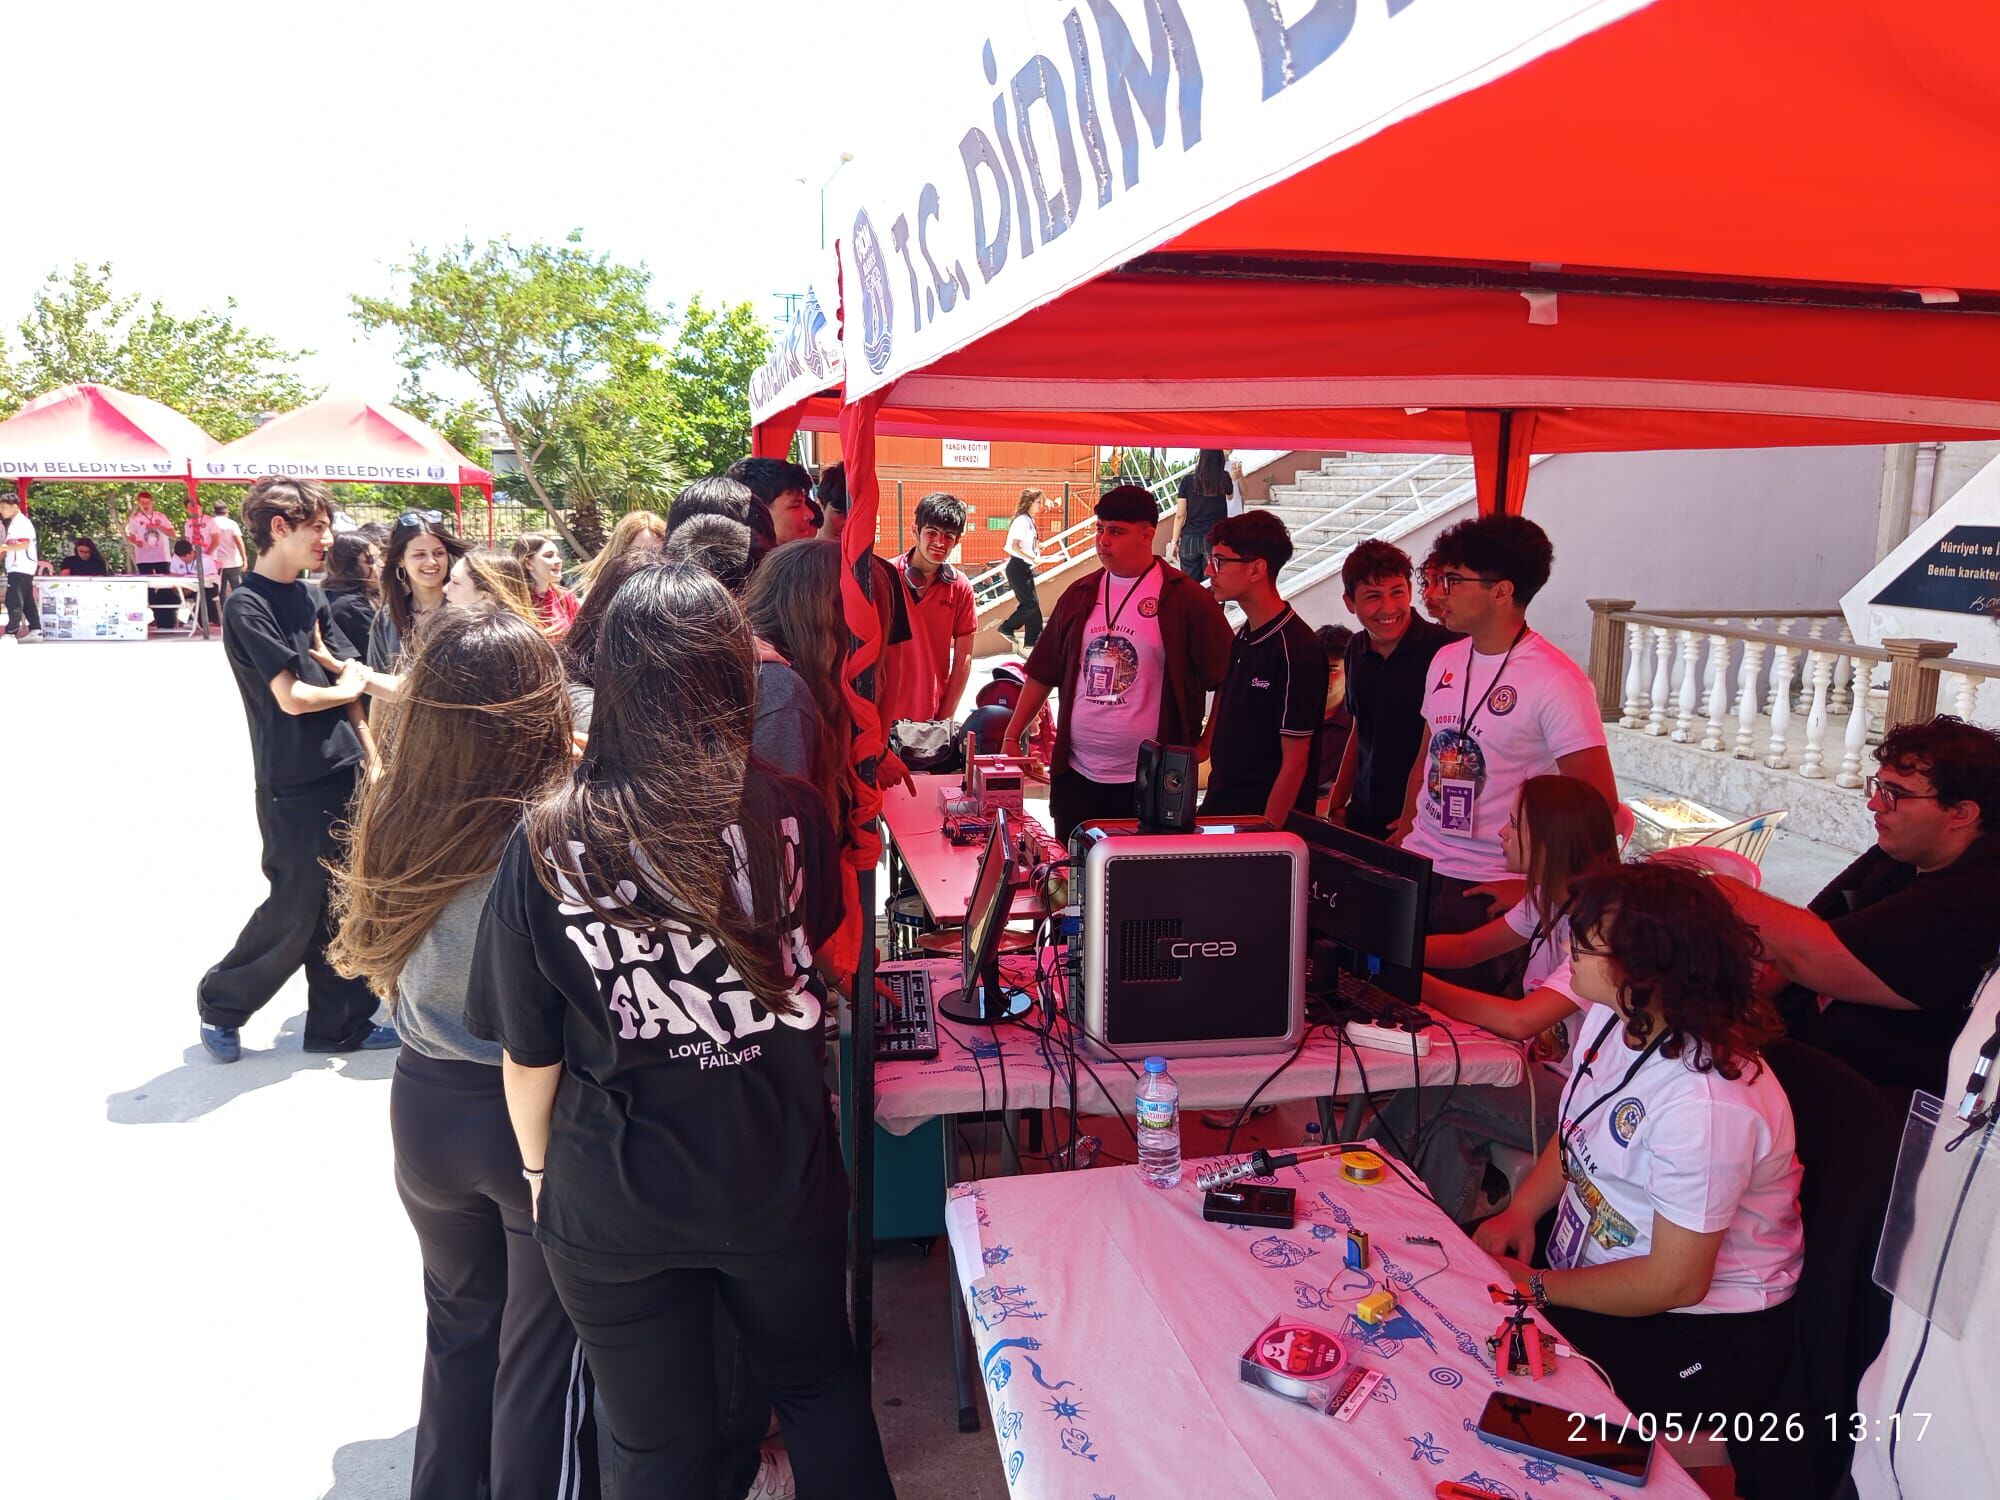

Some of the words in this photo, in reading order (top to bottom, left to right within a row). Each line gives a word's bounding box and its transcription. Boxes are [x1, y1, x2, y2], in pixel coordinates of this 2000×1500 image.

[232, 464, 263, 475] T.C.
[1940, 541, 1979, 557] Hürriyet
[1982, 545, 1993, 556] ve
[1927, 563, 1956, 577] Benim
[1958, 565, 2000, 581] karakter
[1171, 941, 1237, 959] crea
[668, 1041, 713, 1059] LOVE
[1679, 1362, 1702, 1379] OYSHO
